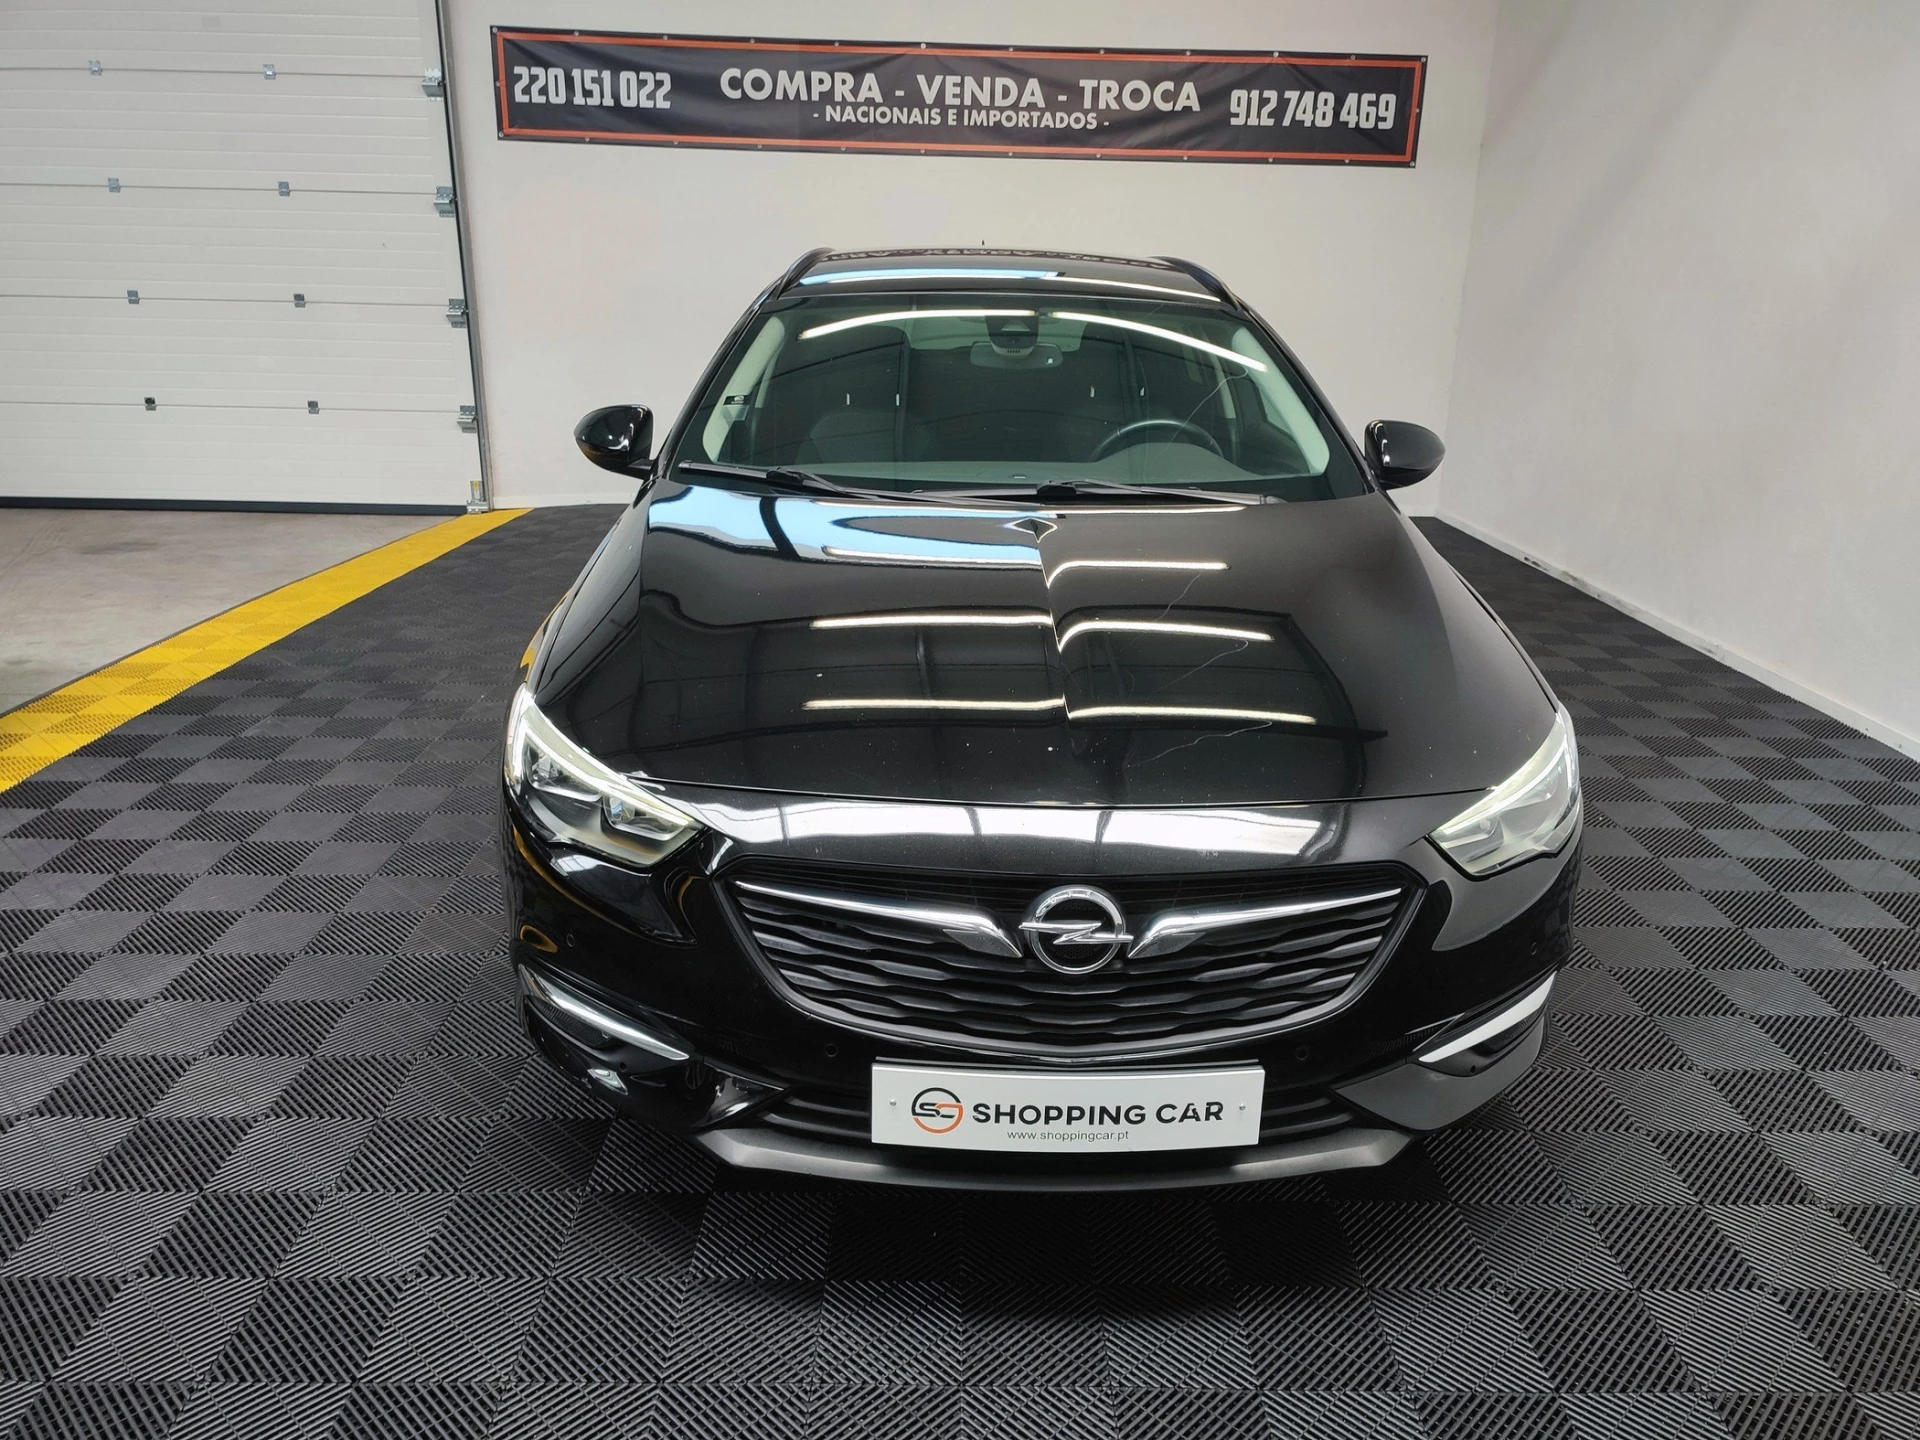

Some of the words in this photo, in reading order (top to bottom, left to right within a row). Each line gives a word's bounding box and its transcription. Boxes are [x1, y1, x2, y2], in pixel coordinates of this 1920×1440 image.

[513, 66, 566, 104] 220
[571, 68, 615, 107] 151
[619, 71, 672, 109] 022
[720, 68, 883, 103] COMPRA
[916, 74, 1046, 107] VENDA
[1078, 79, 1201, 112] TROCA
[825, 105, 942, 125] NACIONAIS
[946, 112, 957, 126] E
[963, 112, 1097, 130] IMPORTADOS
[1229, 89, 1275, 126] 912
[1281, 91, 1335, 127] 748
[1339, 93, 1396, 129] 469
[972, 1103, 1146, 1126] SHOPPING
[1156, 1101, 1223, 1122] CAR
[1007, 1130, 1129, 1142] www.shoppingcar.pt
